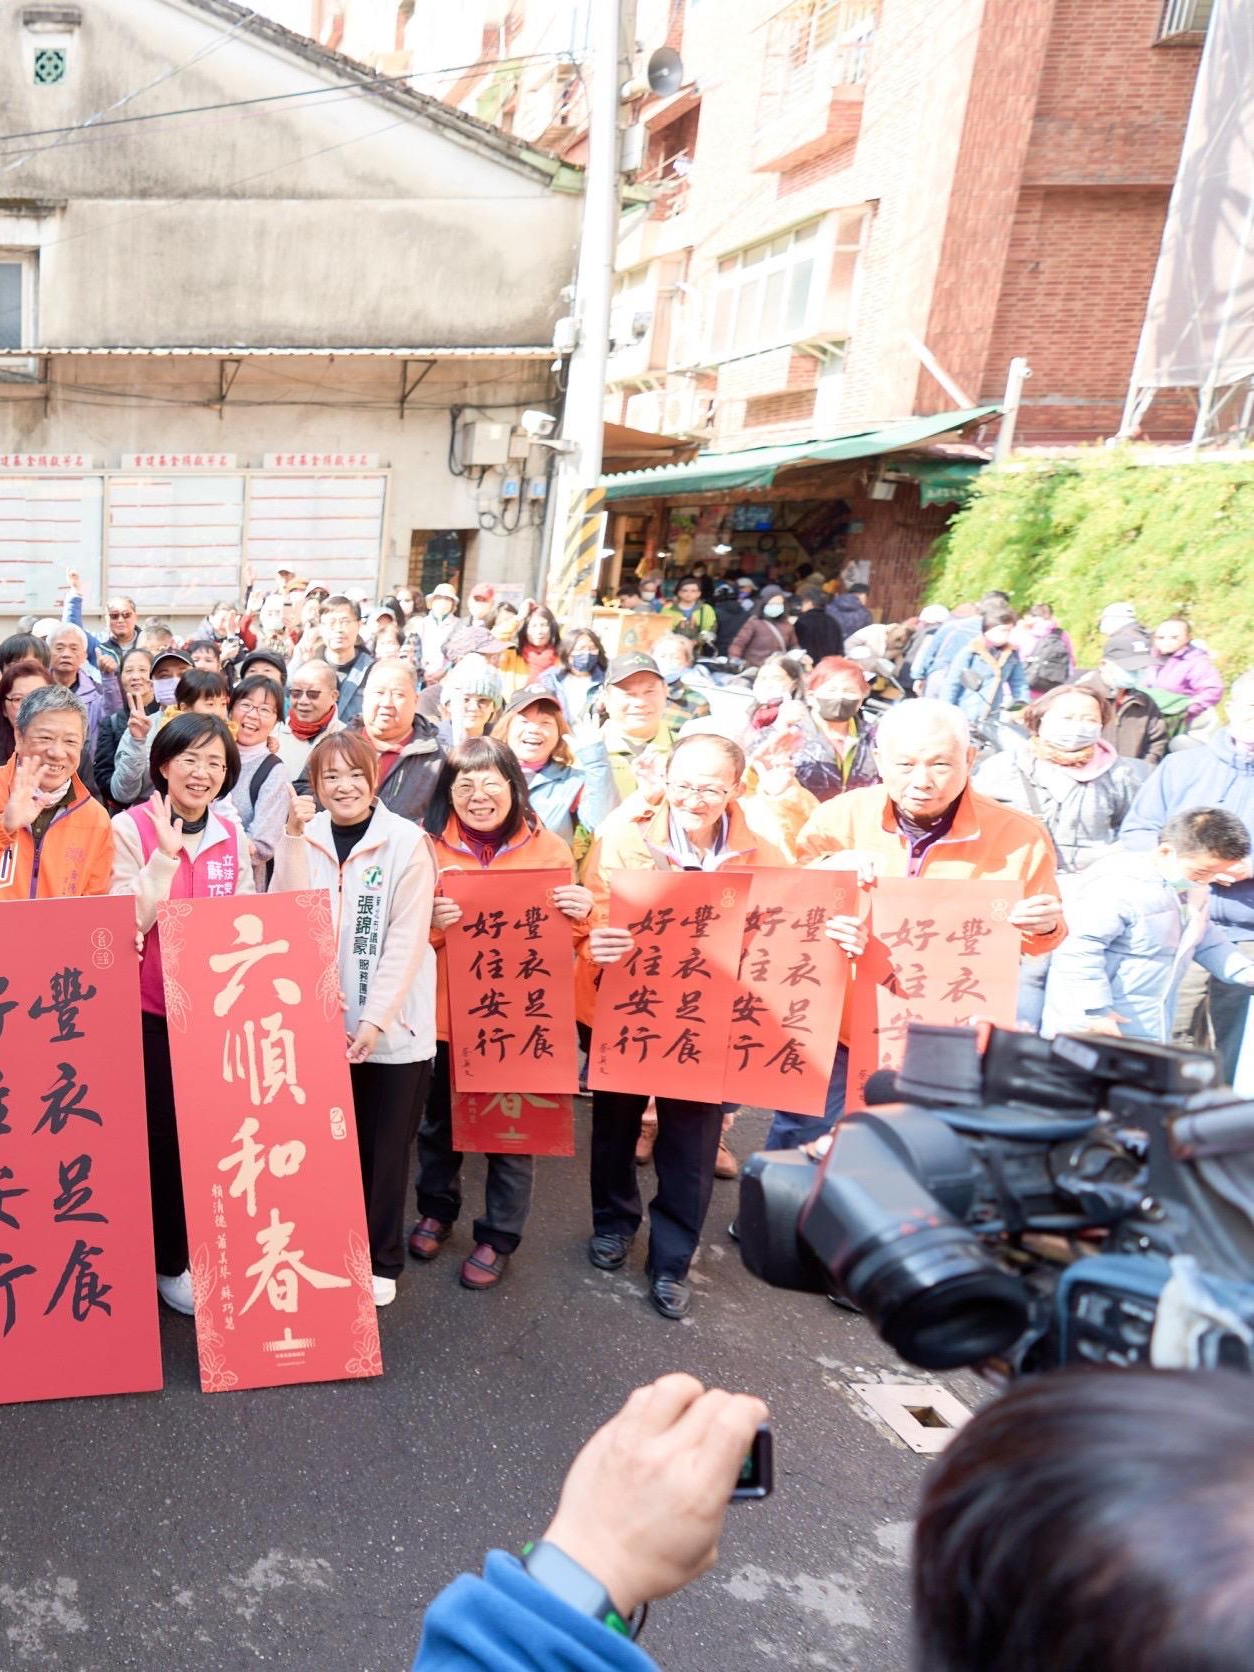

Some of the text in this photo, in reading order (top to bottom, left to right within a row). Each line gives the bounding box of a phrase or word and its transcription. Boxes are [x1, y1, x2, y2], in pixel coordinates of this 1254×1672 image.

[353, 895, 374, 955] 張錦豪
[462, 910, 516, 1063] 好住安行
[513, 906, 555, 1060] 豐衣足食
[614, 907, 677, 1064] 好住安行
[662, 904, 721, 1065] 豐衣足食
[764, 905, 828, 1076] 豐衣足食
[28, 966, 114, 1323] 豐衣足食
[209, 913, 352, 1317] 六順和春
[211, 1183, 228, 1228] 賴清德
